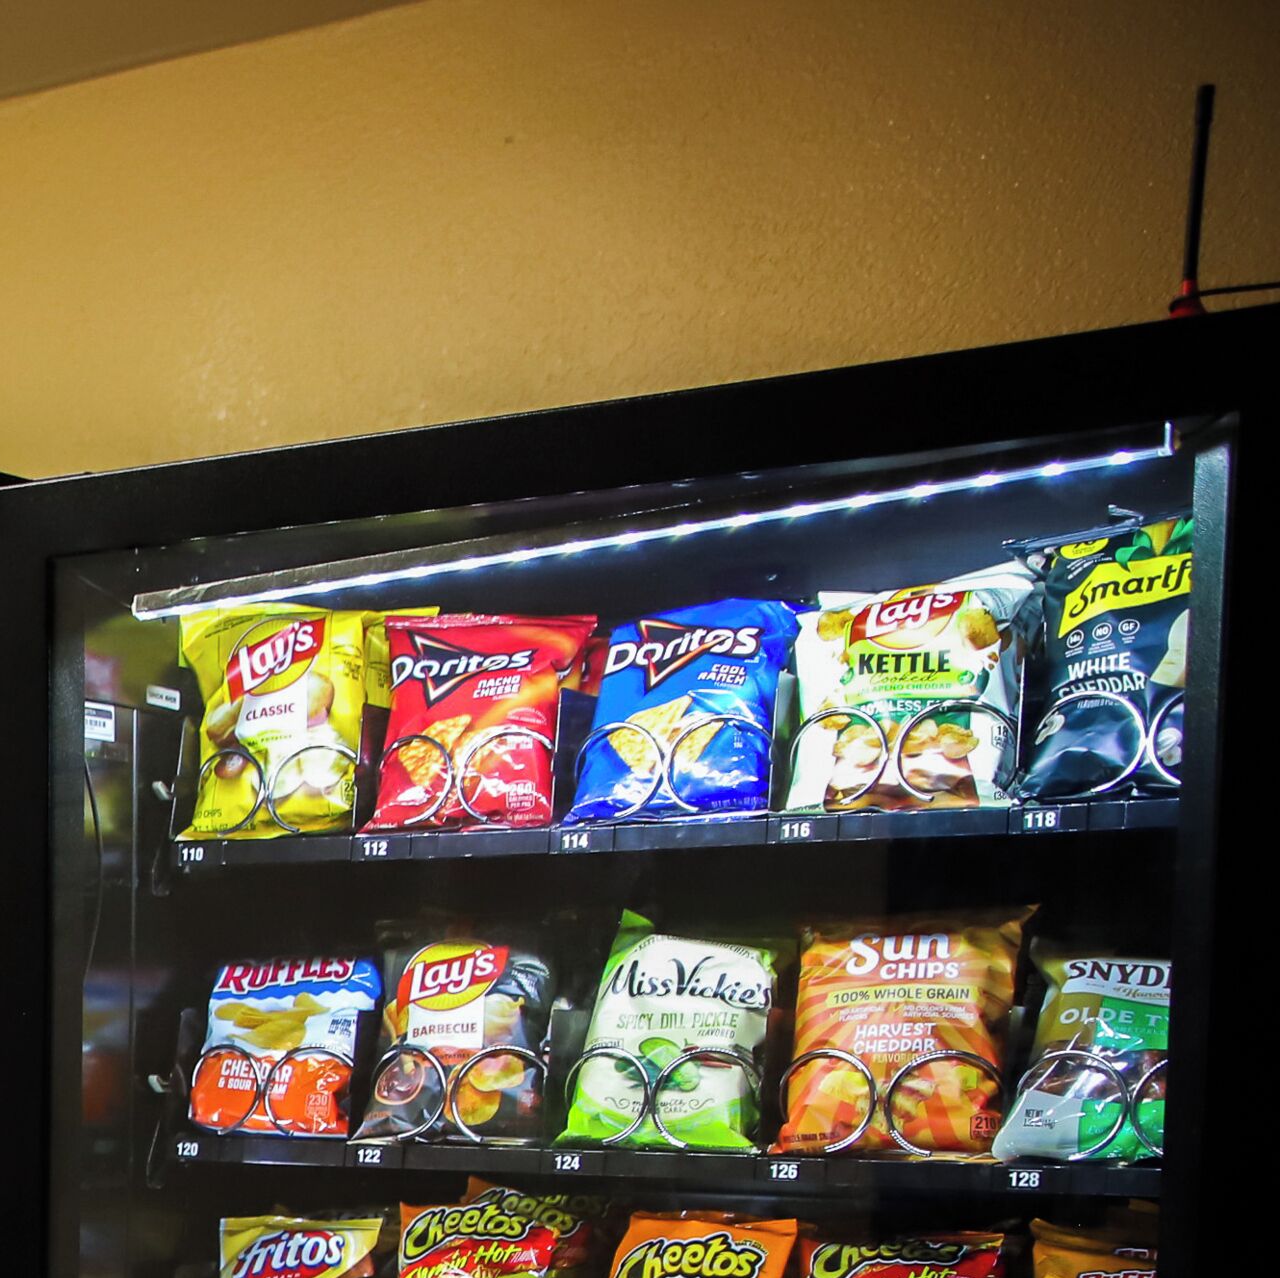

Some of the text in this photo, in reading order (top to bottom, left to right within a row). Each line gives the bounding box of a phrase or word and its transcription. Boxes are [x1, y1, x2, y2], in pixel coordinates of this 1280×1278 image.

[1068, 558, 1192, 619] Smartf
[239, 620, 317, 691] Lay's
[604, 627, 761, 676] Doritos
[390, 648, 533, 691] Doritos
[711, 664, 746, 676] COOL
[858, 650, 951, 675] KETTLE
[1067, 652, 1131, 680] WHITE
[477, 675, 521, 689] NACHO
[697, 673, 747, 686] RANCH
[1058, 673, 1146, 701] CHEDDAR
[473, 684, 521, 698] CHEESE
[245, 702, 296, 722] CLASSIC
[1024, 812, 1056, 829] 118
[781, 821, 811, 838] 116
[363, 841, 388, 856] 112
[562, 835, 589, 849] 114
[182, 847, 204, 862] 110
[847, 931, 952, 977] Sun
[217, 957, 354, 993] RUFFLES
[410, 948, 497, 1002] Lay's
[879, 962, 960, 981] CHIPS
[833, 988, 970, 1004] 100% WHOLE GRAIN
[616, 1012, 739, 1030] SPICY DILL PICKLE
[1059, 1007, 1133, 1025] OLDE
[411, 1021, 478, 1039] BARBECUE
[697, 1029, 736, 1039] FLAVORED
[854, 1022, 937, 1041] HARVEST
[853, 1038, 935, 1055] CHEDDAR
[227, 1077, 251, 1092] SOUR
[309, 1094, 328, 1105] 230
[176, 1142, 198, 1157] 120
[357, 1148, 381, 1165] 122
[553, 1155, 581, 1171] 124
[770, 1163, 798, 1180] 126
[1009, 1172, 1040, 1187] 128
[404, 1202, 529, 1260] Cheetos
[474, 1241, 522, 1265] Hot
